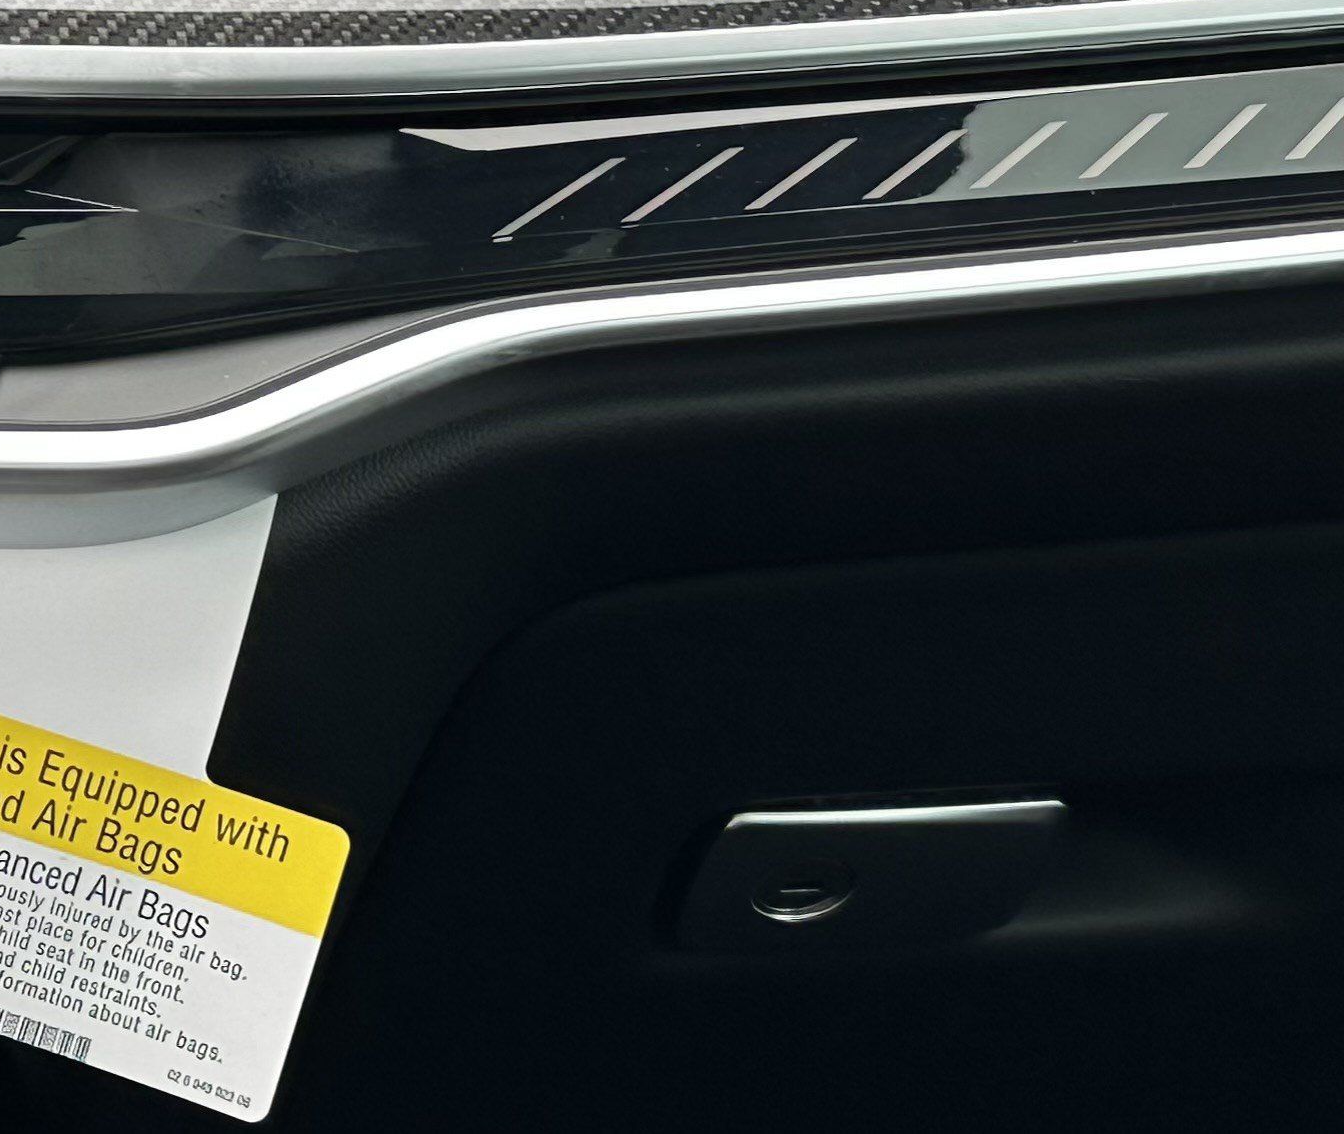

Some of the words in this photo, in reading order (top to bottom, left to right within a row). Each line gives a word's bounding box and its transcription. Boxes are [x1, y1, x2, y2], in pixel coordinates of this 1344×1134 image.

[31, 799, 88, 843] Air
[95, 816, 182, 876] Bags
[38, 749, 206, 833] Equipped
[216, 813, 290, 863] with
[50, 896, 113, 933] injured
[118, 919, 142, 945] by
[145, 929, 174, 953] the
[179, 943, 205, 964] air
[210, 951, 248, 982] bag.
[85, 873, 132, 912] Air
[137, 888, 210, 939] Bags
[25, 916, 74, 942] place
[79, 929, 107, 953] for
[111, 942, 190, 983] children.
[36, 941, 75, 966] seat
[79, 952, 96, 973] in
[101, 959, 130, 984] the
[135, 970, 185, 1004] front.
[20, 958, 67, 985] child
[70, 974, 162, 1018] restraints.
[88, 1003, 142, 1033] about
[145, 1022, 171, 1043] air
[176, 1030, 223, 1064] bags.
